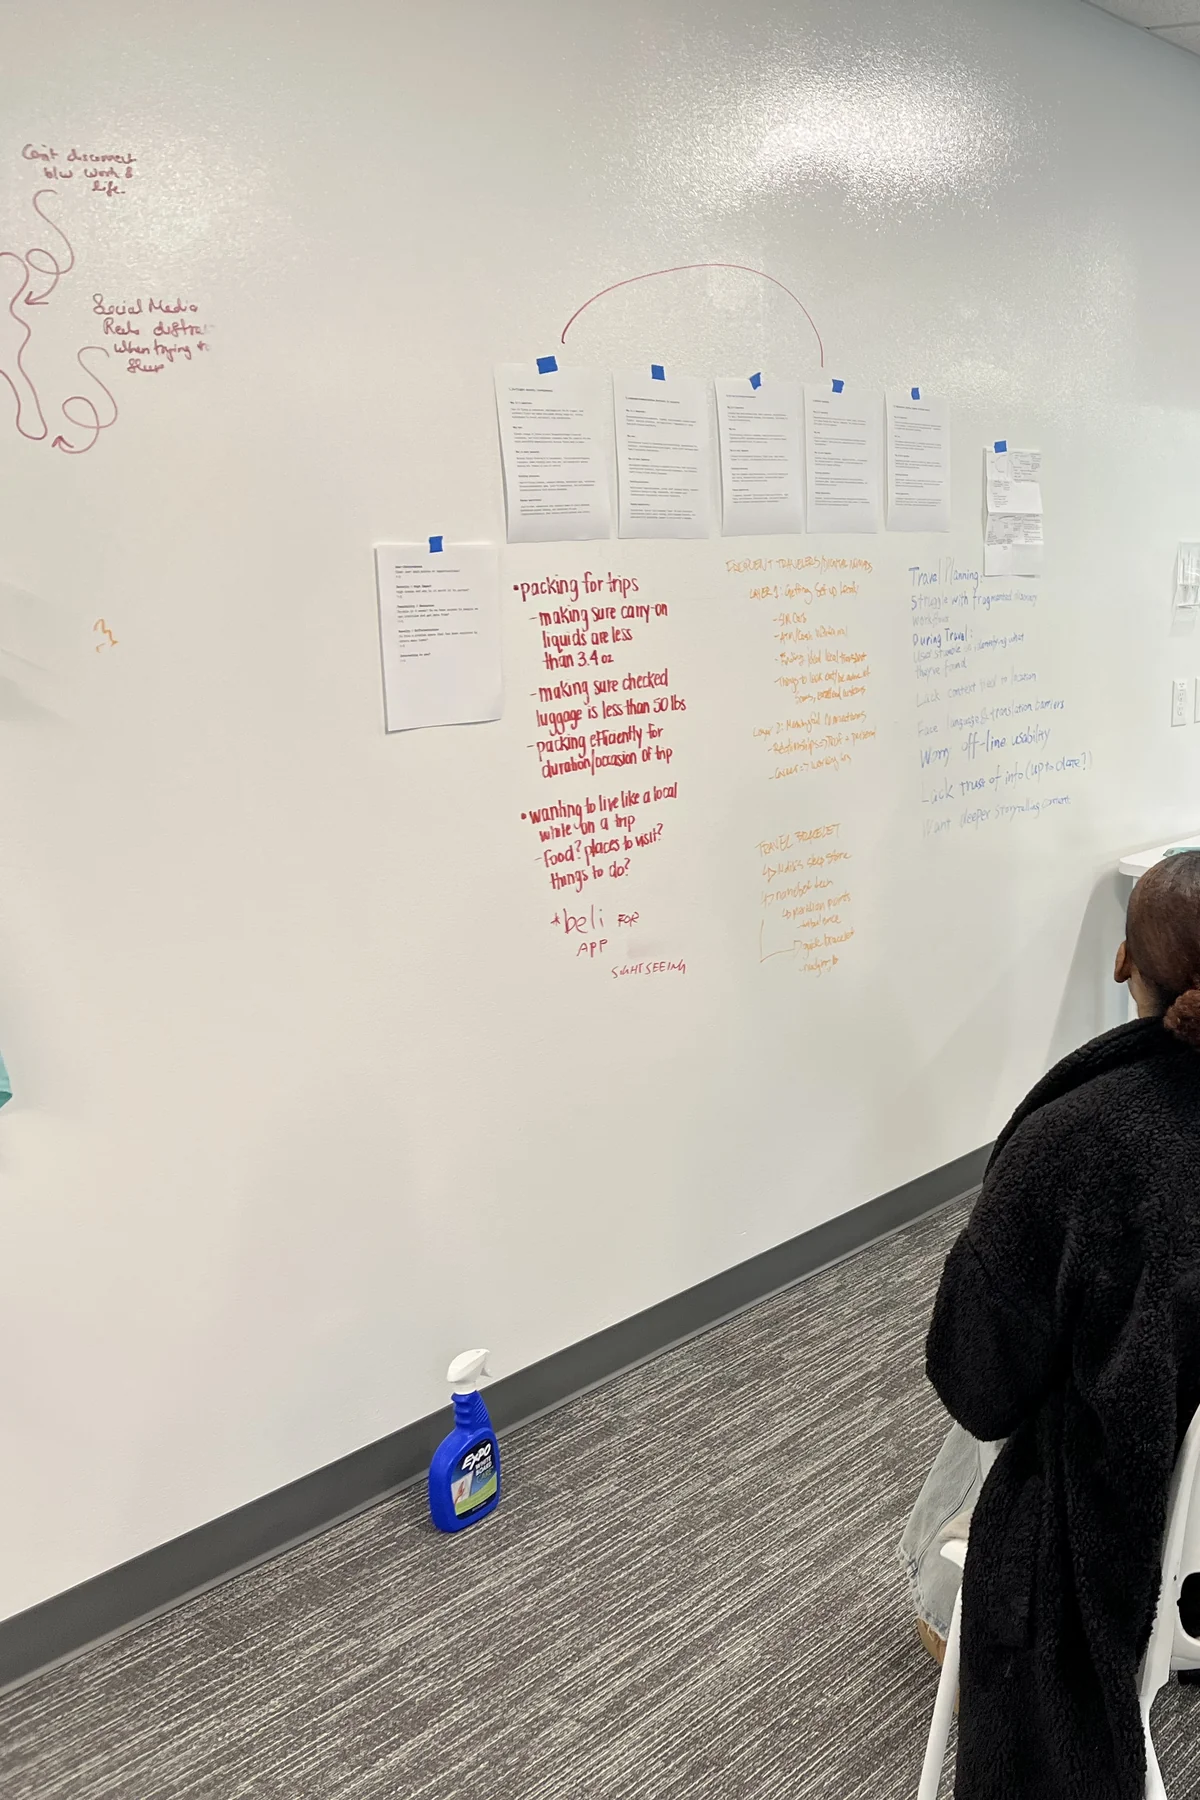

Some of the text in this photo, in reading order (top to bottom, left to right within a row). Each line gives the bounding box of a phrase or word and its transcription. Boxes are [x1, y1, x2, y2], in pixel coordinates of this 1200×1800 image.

[93, 293, 197, 315] Social Media
[154, 339, 191, 361] trying
[908, 557, 941, 587] Travel
[520, 571, 639, 602] packing for trips
[911, 590, 948, 611] Struggle
[951, 589, 969, 607] with
[539, 603, 668, 632] making sure carry-on
[542, 626, 633, 653] liquids are less
[913, 633, 942, 648] During
[543, 650, 614, 670] than 3.4 oz
[538, 668, 668, 705] making sure checked
[916, 689, 941, 708] Lack
[947, 681, 977, 699] context
[536, 694, 686, 736] luggage is less than 50 lbs
[989, 698, 1033, 722] translation
[537, 723, 664, 762] packing efficiently for
[642, 747, 652, 762] of
[656, 745, 673, 764] trip
[961, 729, 1007, 760] off-line
[1011, 723, 1052, 752] usability
[920, 777, 955, 805] Lack
[959, 776, 986, 797] trust
[988, 764, 1001, 792] of
[529, 782, 677, 829] wanting to live like a local
[960, 807, 991, 831] deeper
[539, 814, 636, 842] while on a trip
[544, 823, 663, 868] food? places to visit?
[754, 835, 793, 857] TRAVEL
[549, 857, 631, 893] things to do?
[461, 1443, 491, 1470] EXPO
